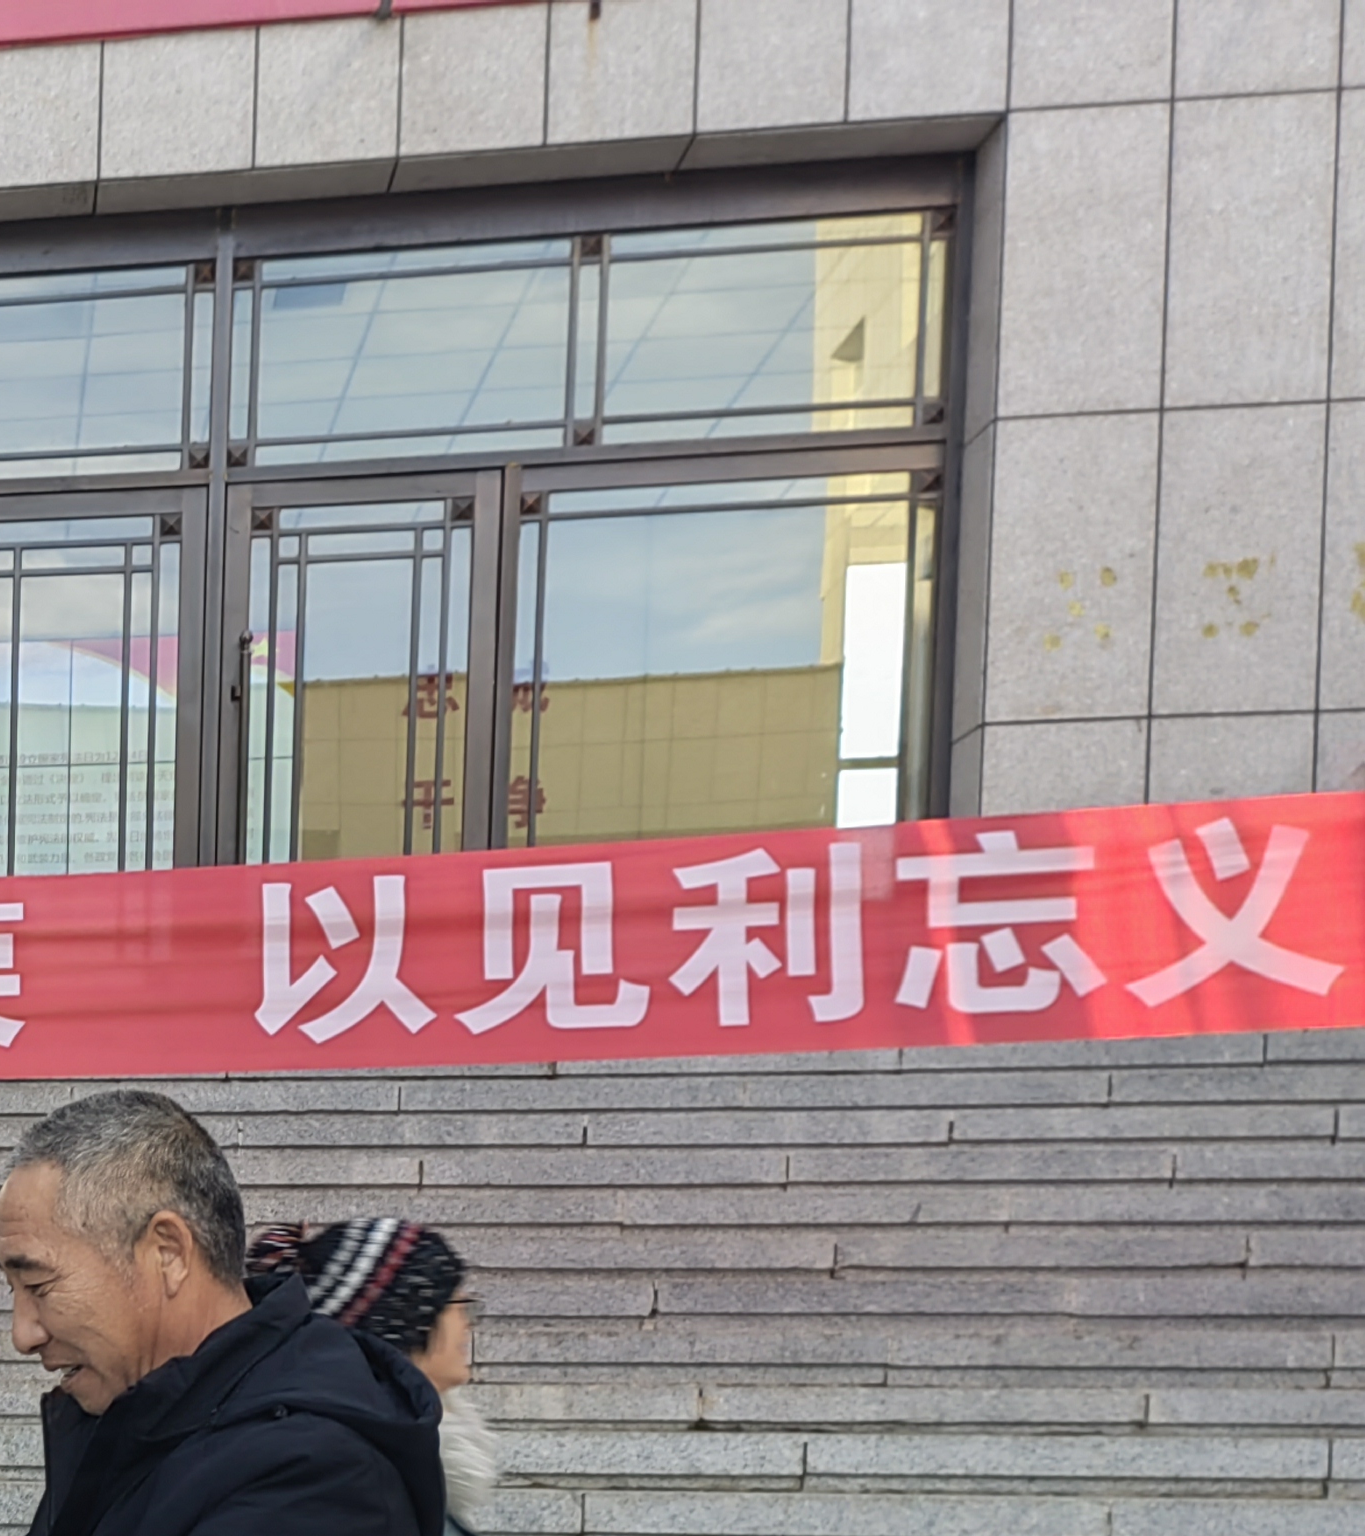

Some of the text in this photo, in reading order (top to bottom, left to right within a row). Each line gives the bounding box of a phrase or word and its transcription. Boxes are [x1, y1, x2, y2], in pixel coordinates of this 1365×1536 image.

[255, 817, 1346, 1044] 以见利忘义
